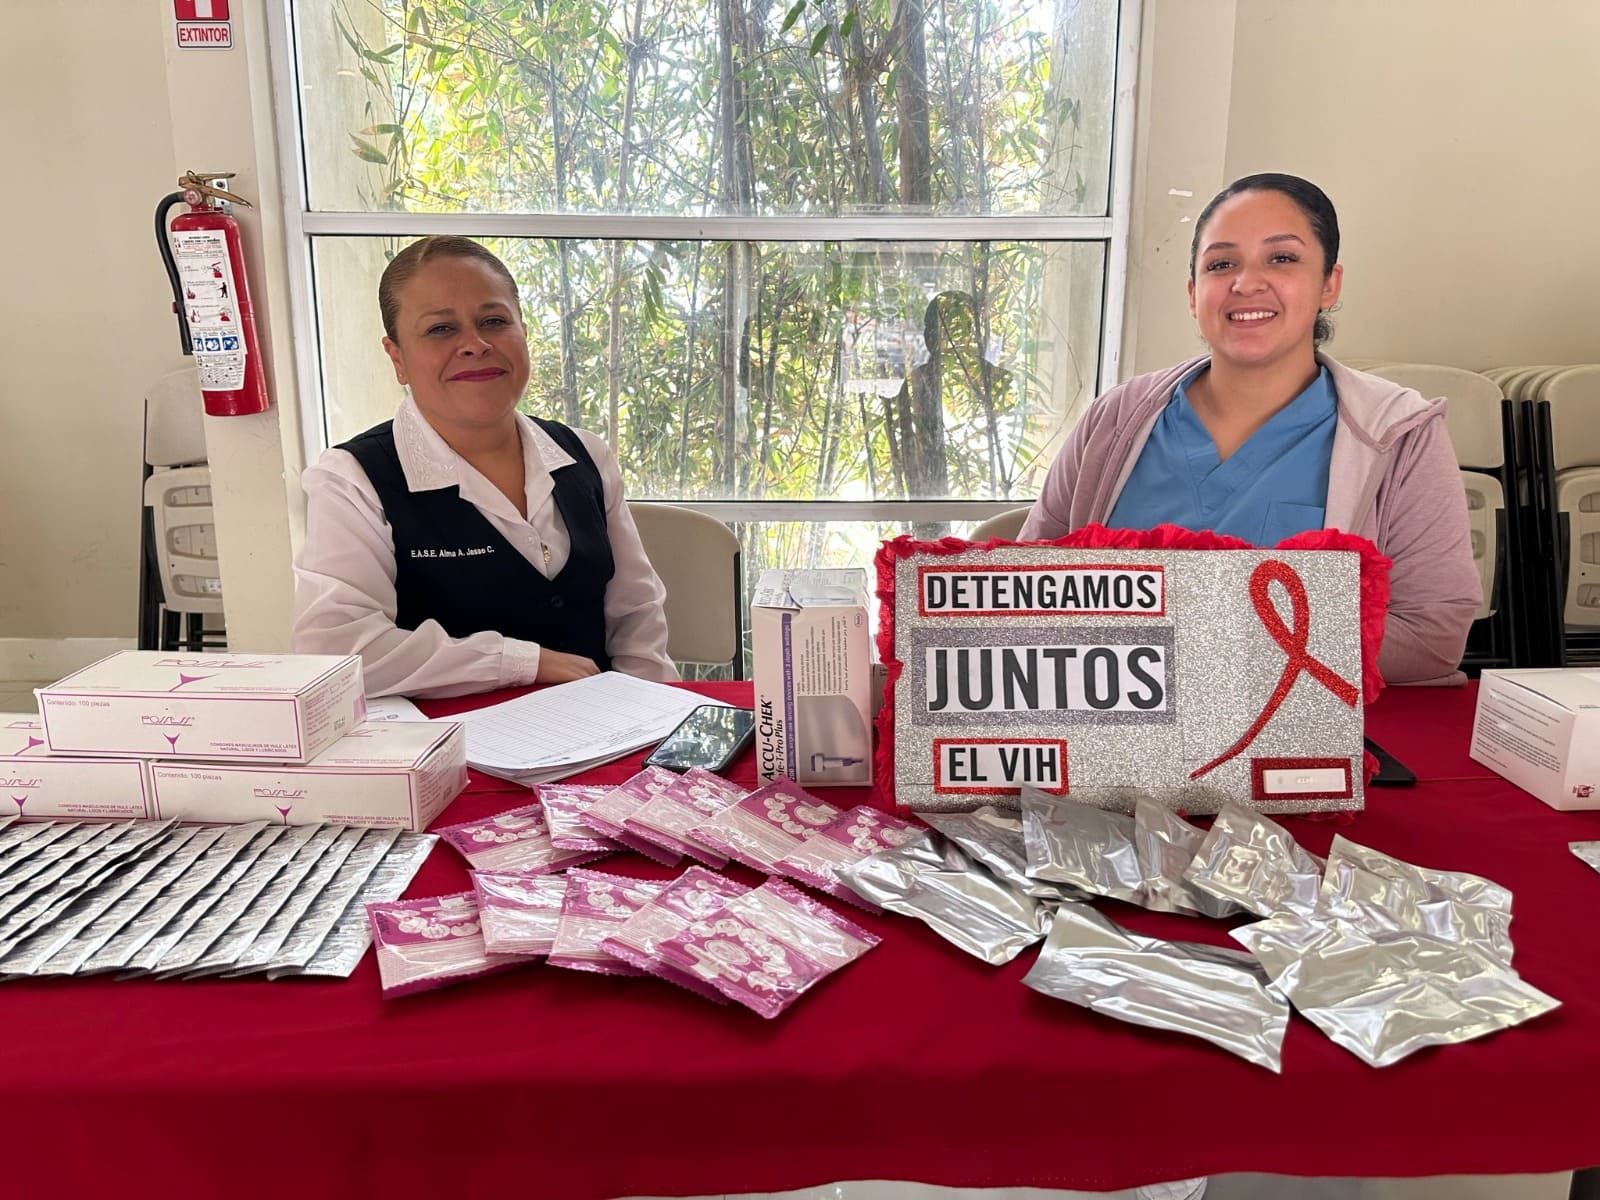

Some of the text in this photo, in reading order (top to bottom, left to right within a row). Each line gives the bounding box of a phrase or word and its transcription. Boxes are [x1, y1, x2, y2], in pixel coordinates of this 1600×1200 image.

[179, 27, 229, 42] EXTINTOR
[439, 549, 456, 558] Alma
[927, 574, 1157, 609] DETENGAMOS
[928, 646, 1164, 711] JUNTOS
[759, 699, 775, 782] ACCU-CHEK
[774, 719, 785, 776] fe-T-Pro Plus
[949, 747, 1057, 782] EL VIH
